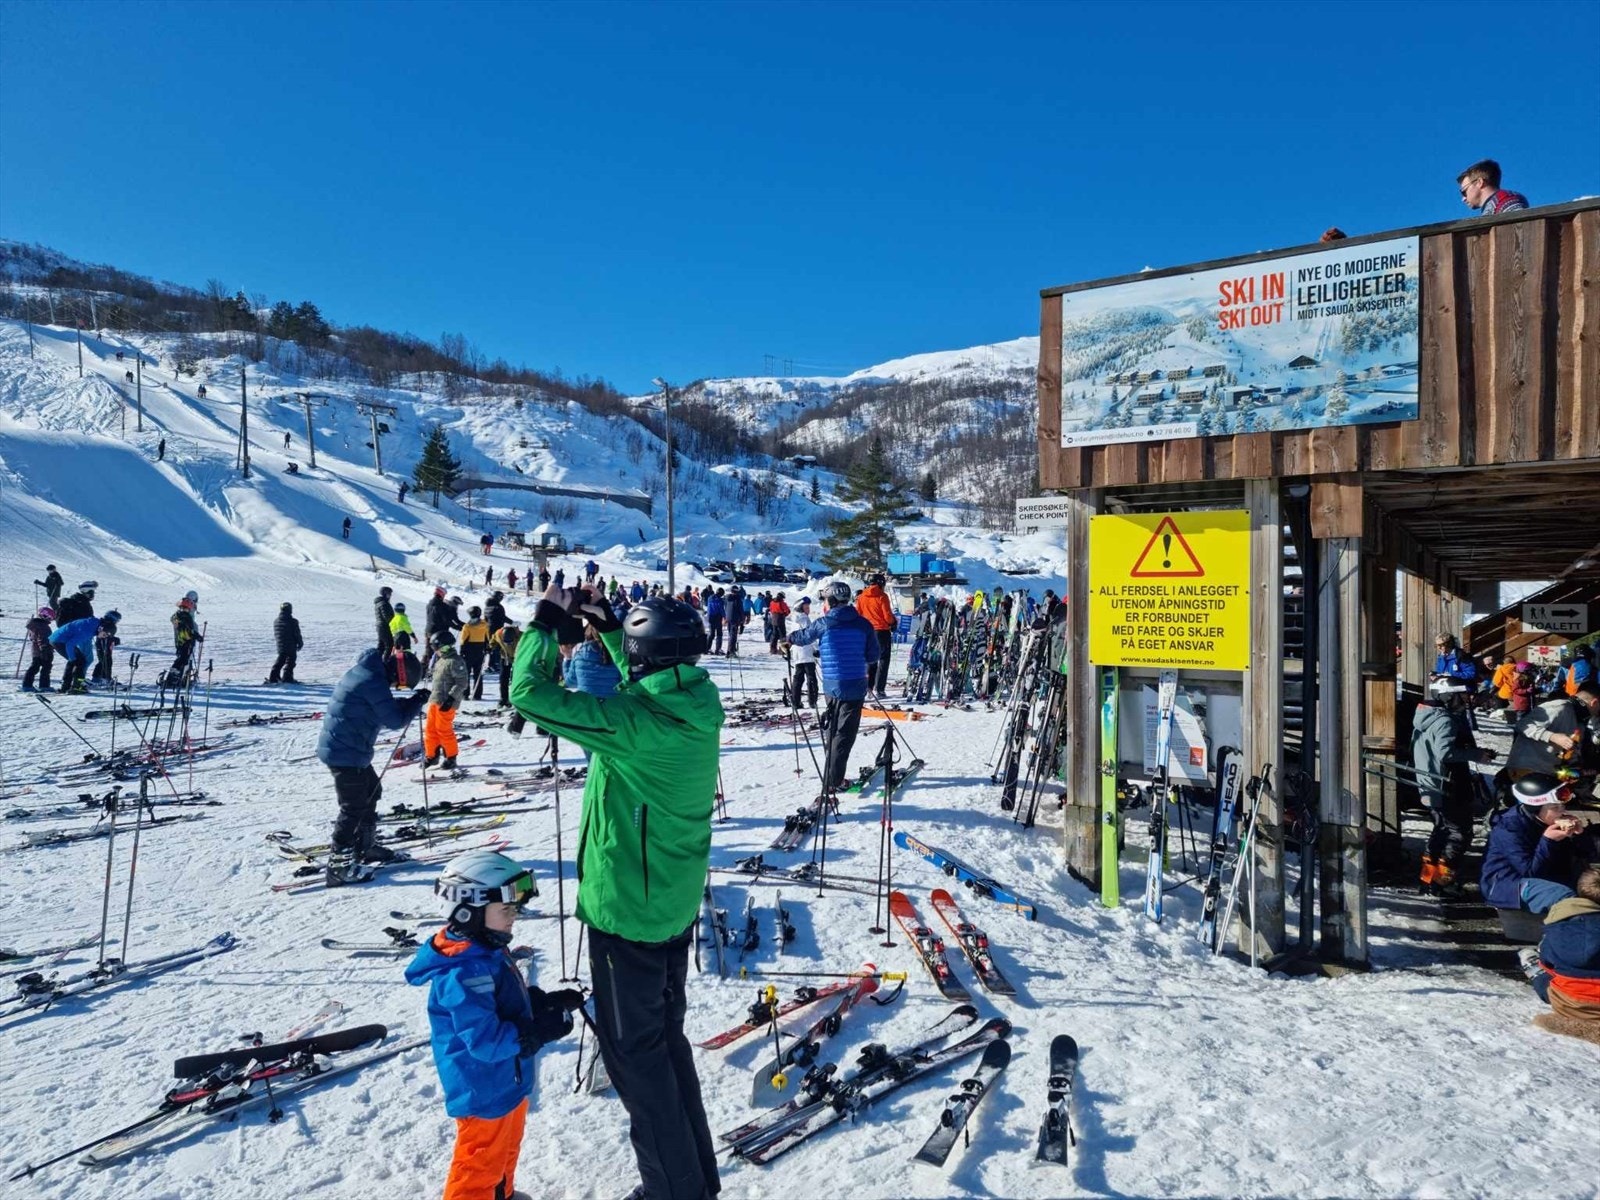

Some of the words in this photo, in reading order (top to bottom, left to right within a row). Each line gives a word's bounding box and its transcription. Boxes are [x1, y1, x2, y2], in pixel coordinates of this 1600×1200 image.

[1298, 266, 1322, 283] NYE
[1325, 263, 1341, 279] OG
[1344, 252, 1406, 276] MODERNE
[1219, 277, 1254, 307] SKI
[1262, 272, 1284, 301] IN
[1298, 272, 1406, 307] LEILIGHETER
[1297, 308, 1319, 321] MIDT
[1320, 308, 1325, 317] I
[1326, 303, 1355, 317] SAUDA
[1356, 296, 1406, 313] SKISENTER
[1218, 308, 1246, 330] SKI
[1250, 302, 1284, 326] OUT
[1018, 503, 1068, 512] SKREDSØKER
[1046, 511, 1068, 519] POINT
[1099, 586, 1118, 596] ALL
[1121, 585, 1169, 596] FERDSEL
[1172, 586, 1175, 595] I
[1178, 585, 1239, 596] ANLEGGET
[1111, 599, 1155, 609] UTENOM
[1158, 597, 1226, 610] ÅPNINGSTID
[1125, 612, 1139, 622] ER
[1142, 612, 1210, 623] FORBUNDET
[1112, 625, 1134, 635] MED
[1137, 626, 1165, 636] FARE
[1168, 626, 1185, 637] OG
[1188, 627, 1224, 637] SKJER
[1529, 622, 1581, 630] TOALETT
[1121, 637, 1135, 648] PÅ
[1138, 639, 1166, 650] EGET
[1169, 640, 1214, 651] ANSVAR
[1121, 656, 1215, 666] www.saudaskisenter.no
[1223, 763, 1238, 812] HEAD
